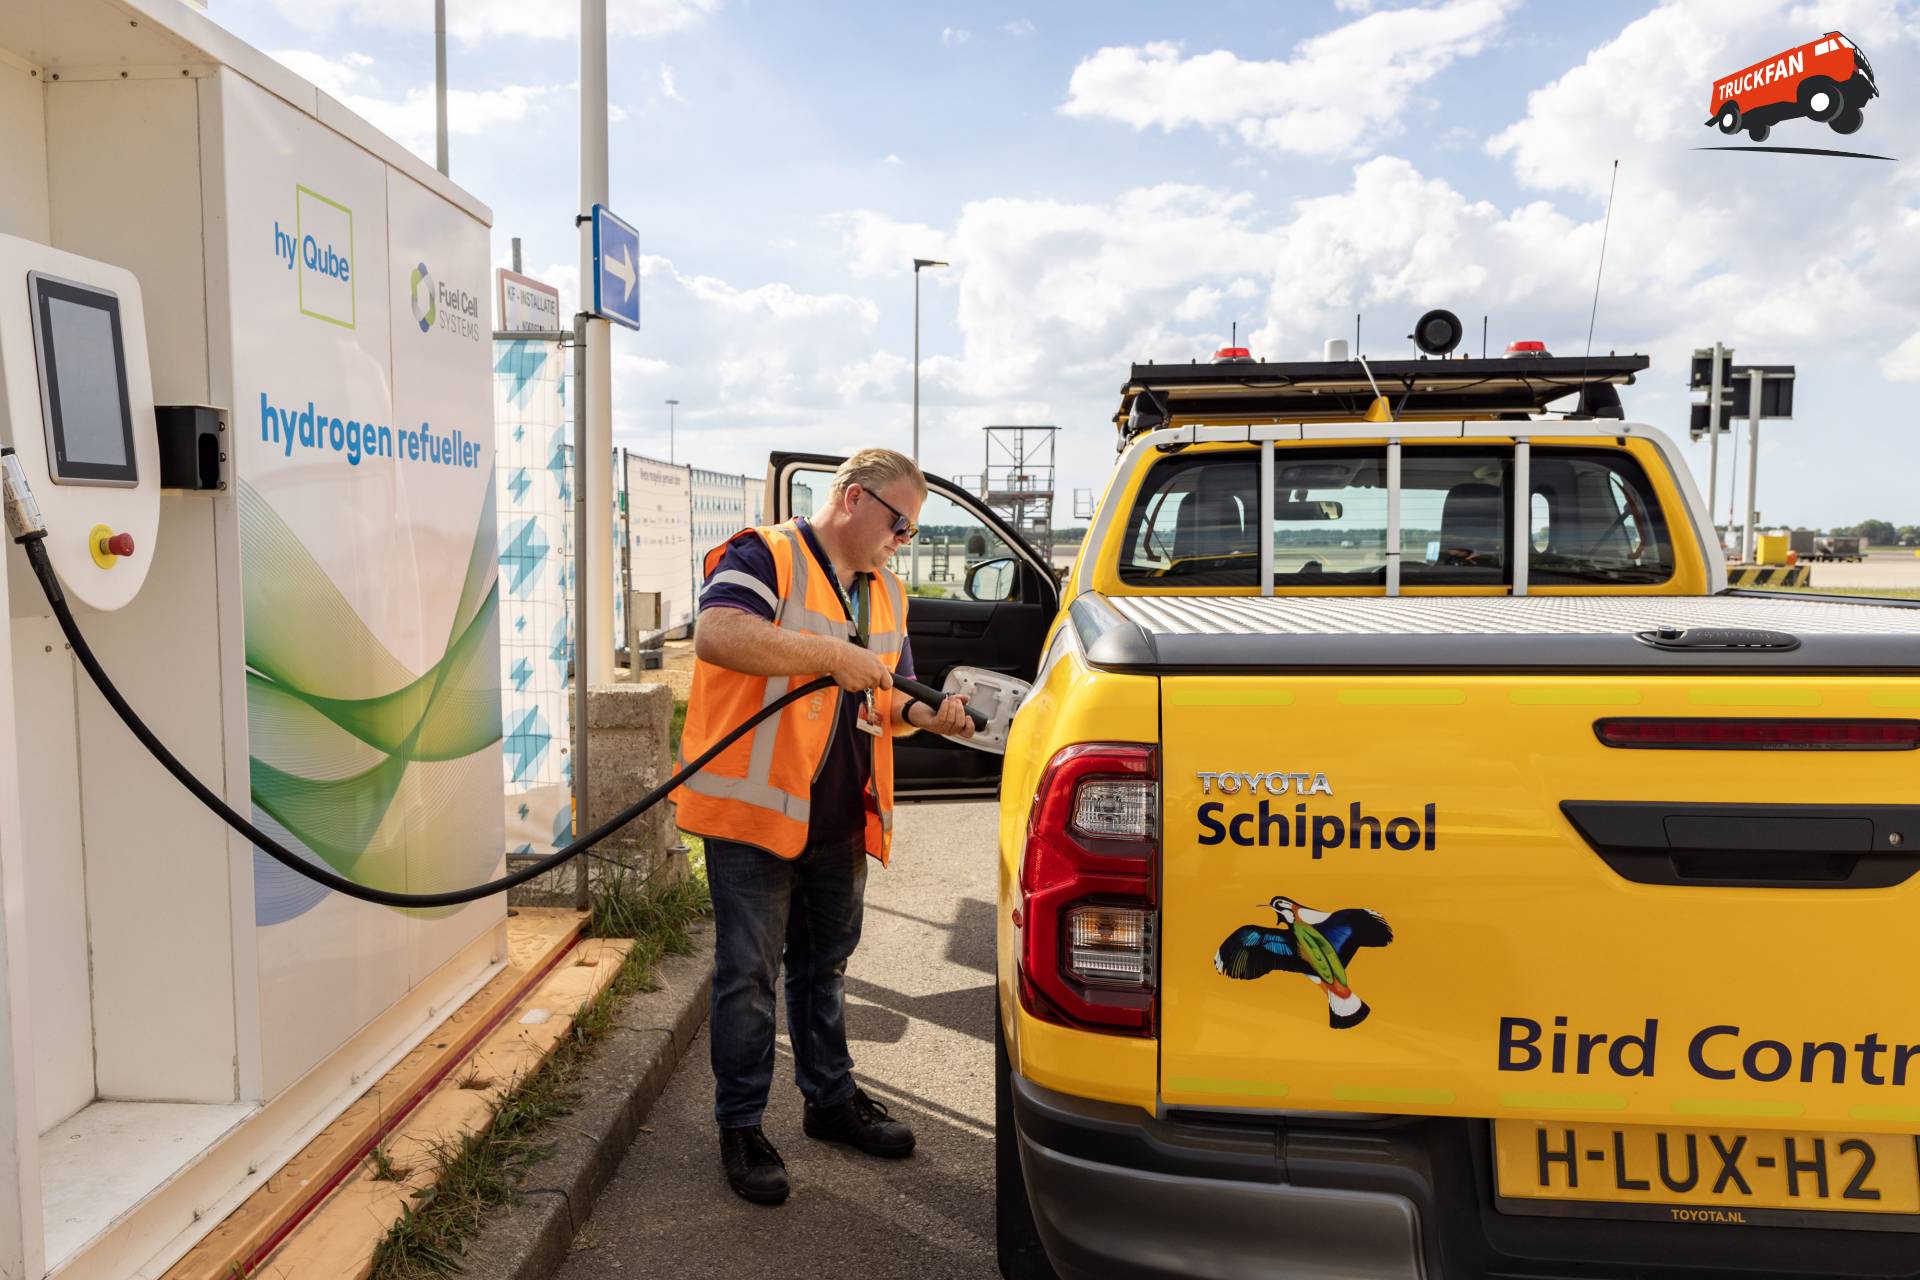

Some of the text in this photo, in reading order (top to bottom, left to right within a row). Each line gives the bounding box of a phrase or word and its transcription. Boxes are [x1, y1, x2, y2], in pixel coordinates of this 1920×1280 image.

[274, 221, 350, 282] hy Qube
[438, 281, 478, 318] Fuel Cell
[439, 310, 480, 342] SYSTEMS
[260, 392, 481, 468] hydrogen refueller
[1197, 771, 1334, 796] TOYOTA
[1197, 799, 1436, 860] Schiphol
[1498, 1015, 1659, 1077] Bird
[1536, 1127, 1882, 1201] H-LUX-H2
[1671, 1209, 1747, 1223] TOYOTA.NL
